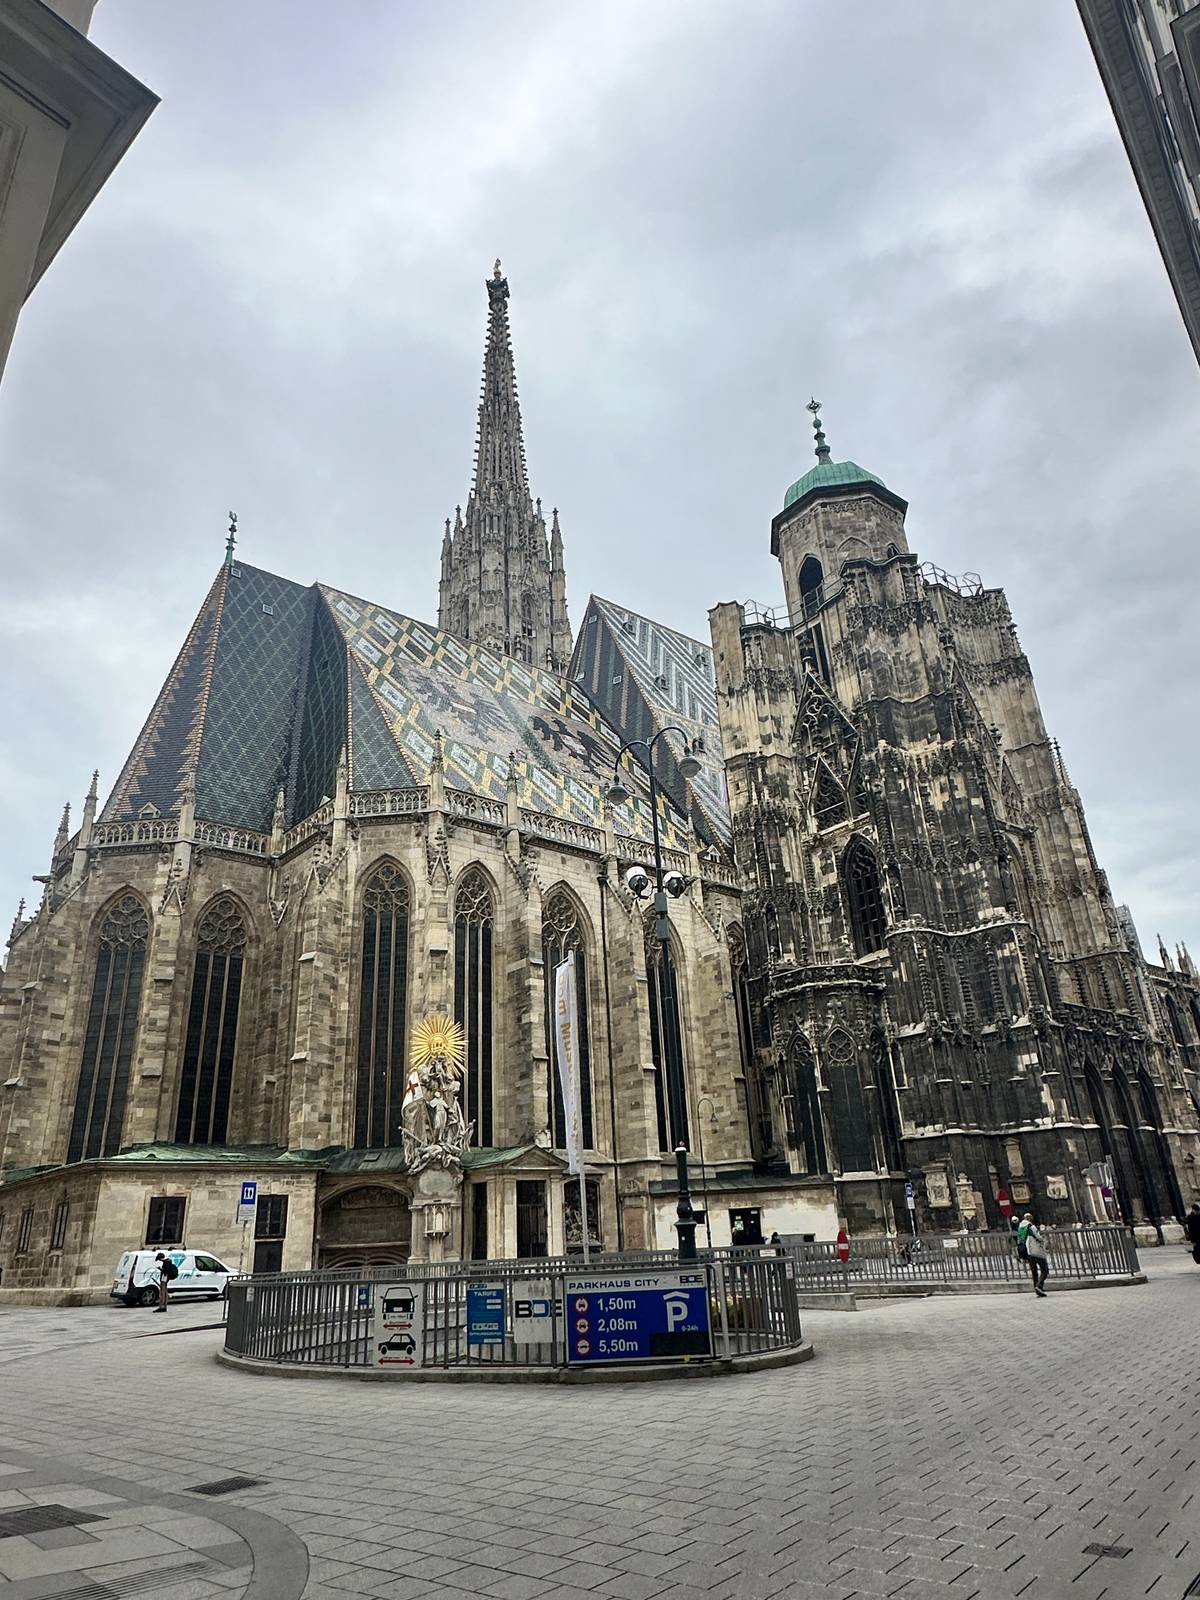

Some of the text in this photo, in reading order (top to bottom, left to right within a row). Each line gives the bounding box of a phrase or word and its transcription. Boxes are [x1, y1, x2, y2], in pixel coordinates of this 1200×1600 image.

[569, 1279, 659, 1289] PARKHAUS CITY
[597, 1298, 636, 1312] 1,50m
[666, 1301, 688, 1332] P
[598, 1319, 637, 1333] 2,08m
[599, 1339, 639, 1354] 5,50m
